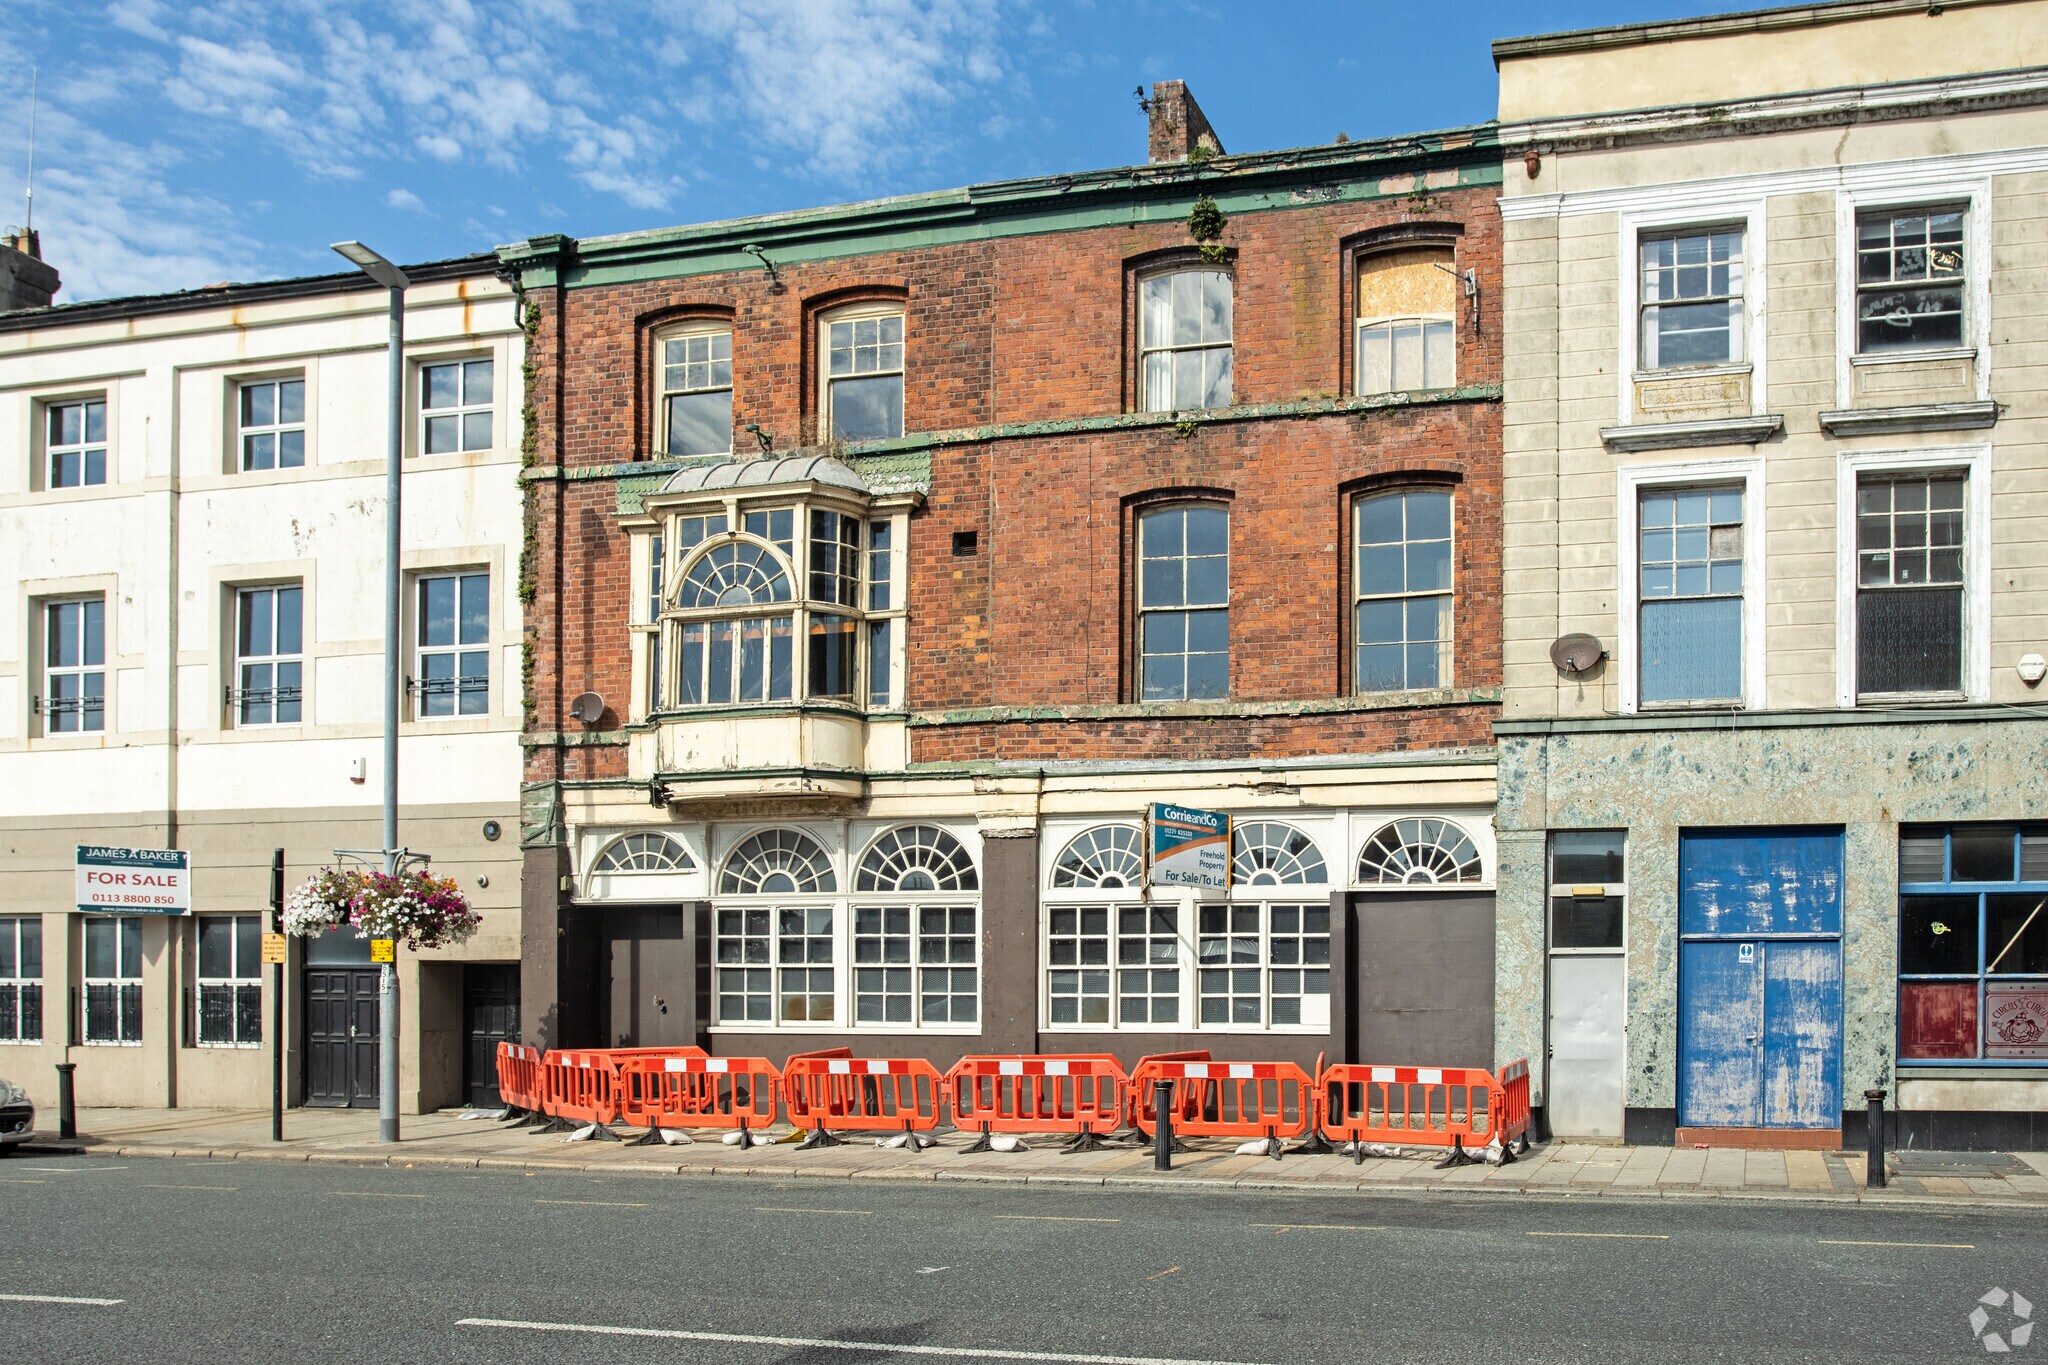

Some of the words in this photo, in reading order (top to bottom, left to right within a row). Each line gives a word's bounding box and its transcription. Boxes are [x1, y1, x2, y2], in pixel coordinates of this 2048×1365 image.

[1164, 807, 1217, 827] CorrieandCo
[86, 848, 126, 859] JAMES
[128, 849, 138, 859] A
[140, 851, 178, 861] BAKER
[1200, 849, 1225, 860] Freehold
[1199, 860, 1225, 872] Property
[87, 872, 126, 885] FOR
[132, 874, 178, 887] SALE
[1165, 870, 1179, 881] For
[1181, 872, 1211, 885] Sale/To
[1213, 876, 1225, 887] Let
[92, 893, 120, 903] 0113
[123, 894, 151, 904] 8800
[154, 895, 175, 905] 850
[1992, 1000, 2019, 1019] CIRCUS
